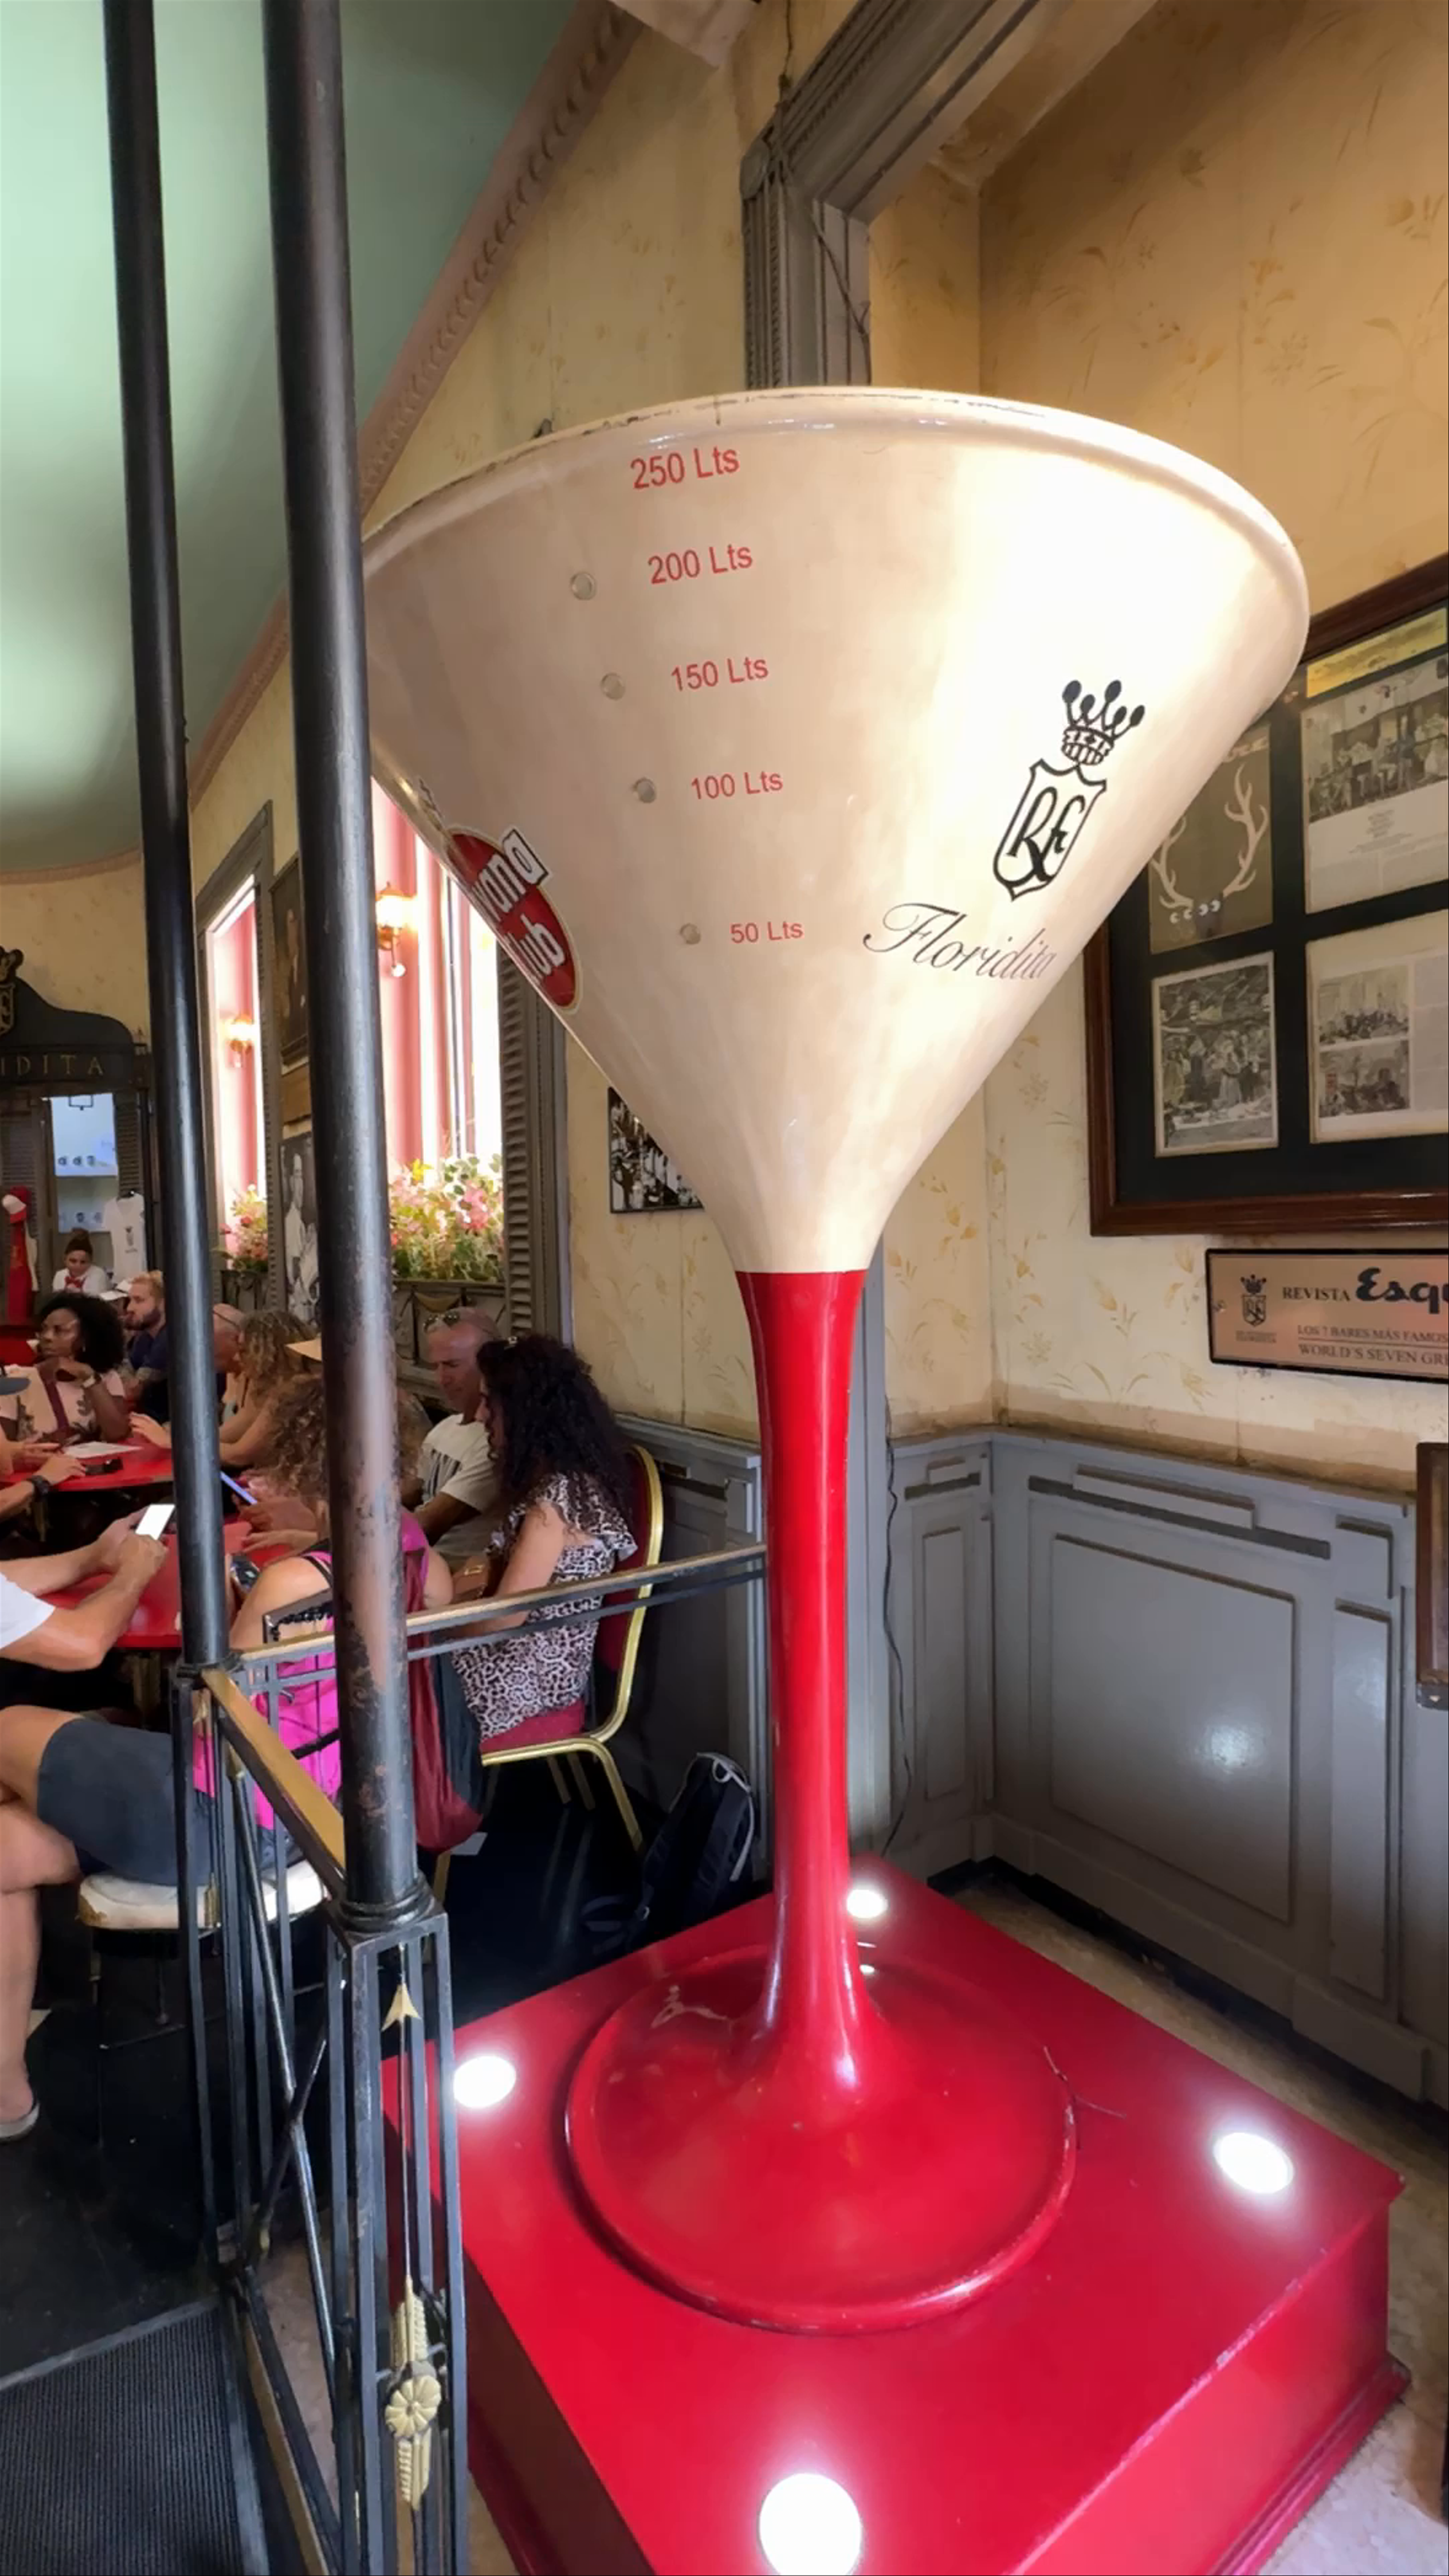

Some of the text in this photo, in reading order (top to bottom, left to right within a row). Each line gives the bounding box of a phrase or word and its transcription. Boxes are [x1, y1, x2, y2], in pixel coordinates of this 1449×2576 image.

[630, 446, 740, 489] 250 Lts
[648, 544, 753, 584] 200 Lts
[671, 657, 769, 692] 150 Lts
[691, 771, 783, 800] 100 Lts
[731, 921, 804, 943] 50 Lts
[863, 903, 1057, 979] Floridita
[1282, 1286, 1351, 1301] REVISTA
[1297, 1325, 1320, 1336] LOS
[1331, 1326, 1371, 1338] BARES
[1298, 1344, 1363, 1360] WORLD'S
[1366, 1348, 1417, 1363] SEVEN
